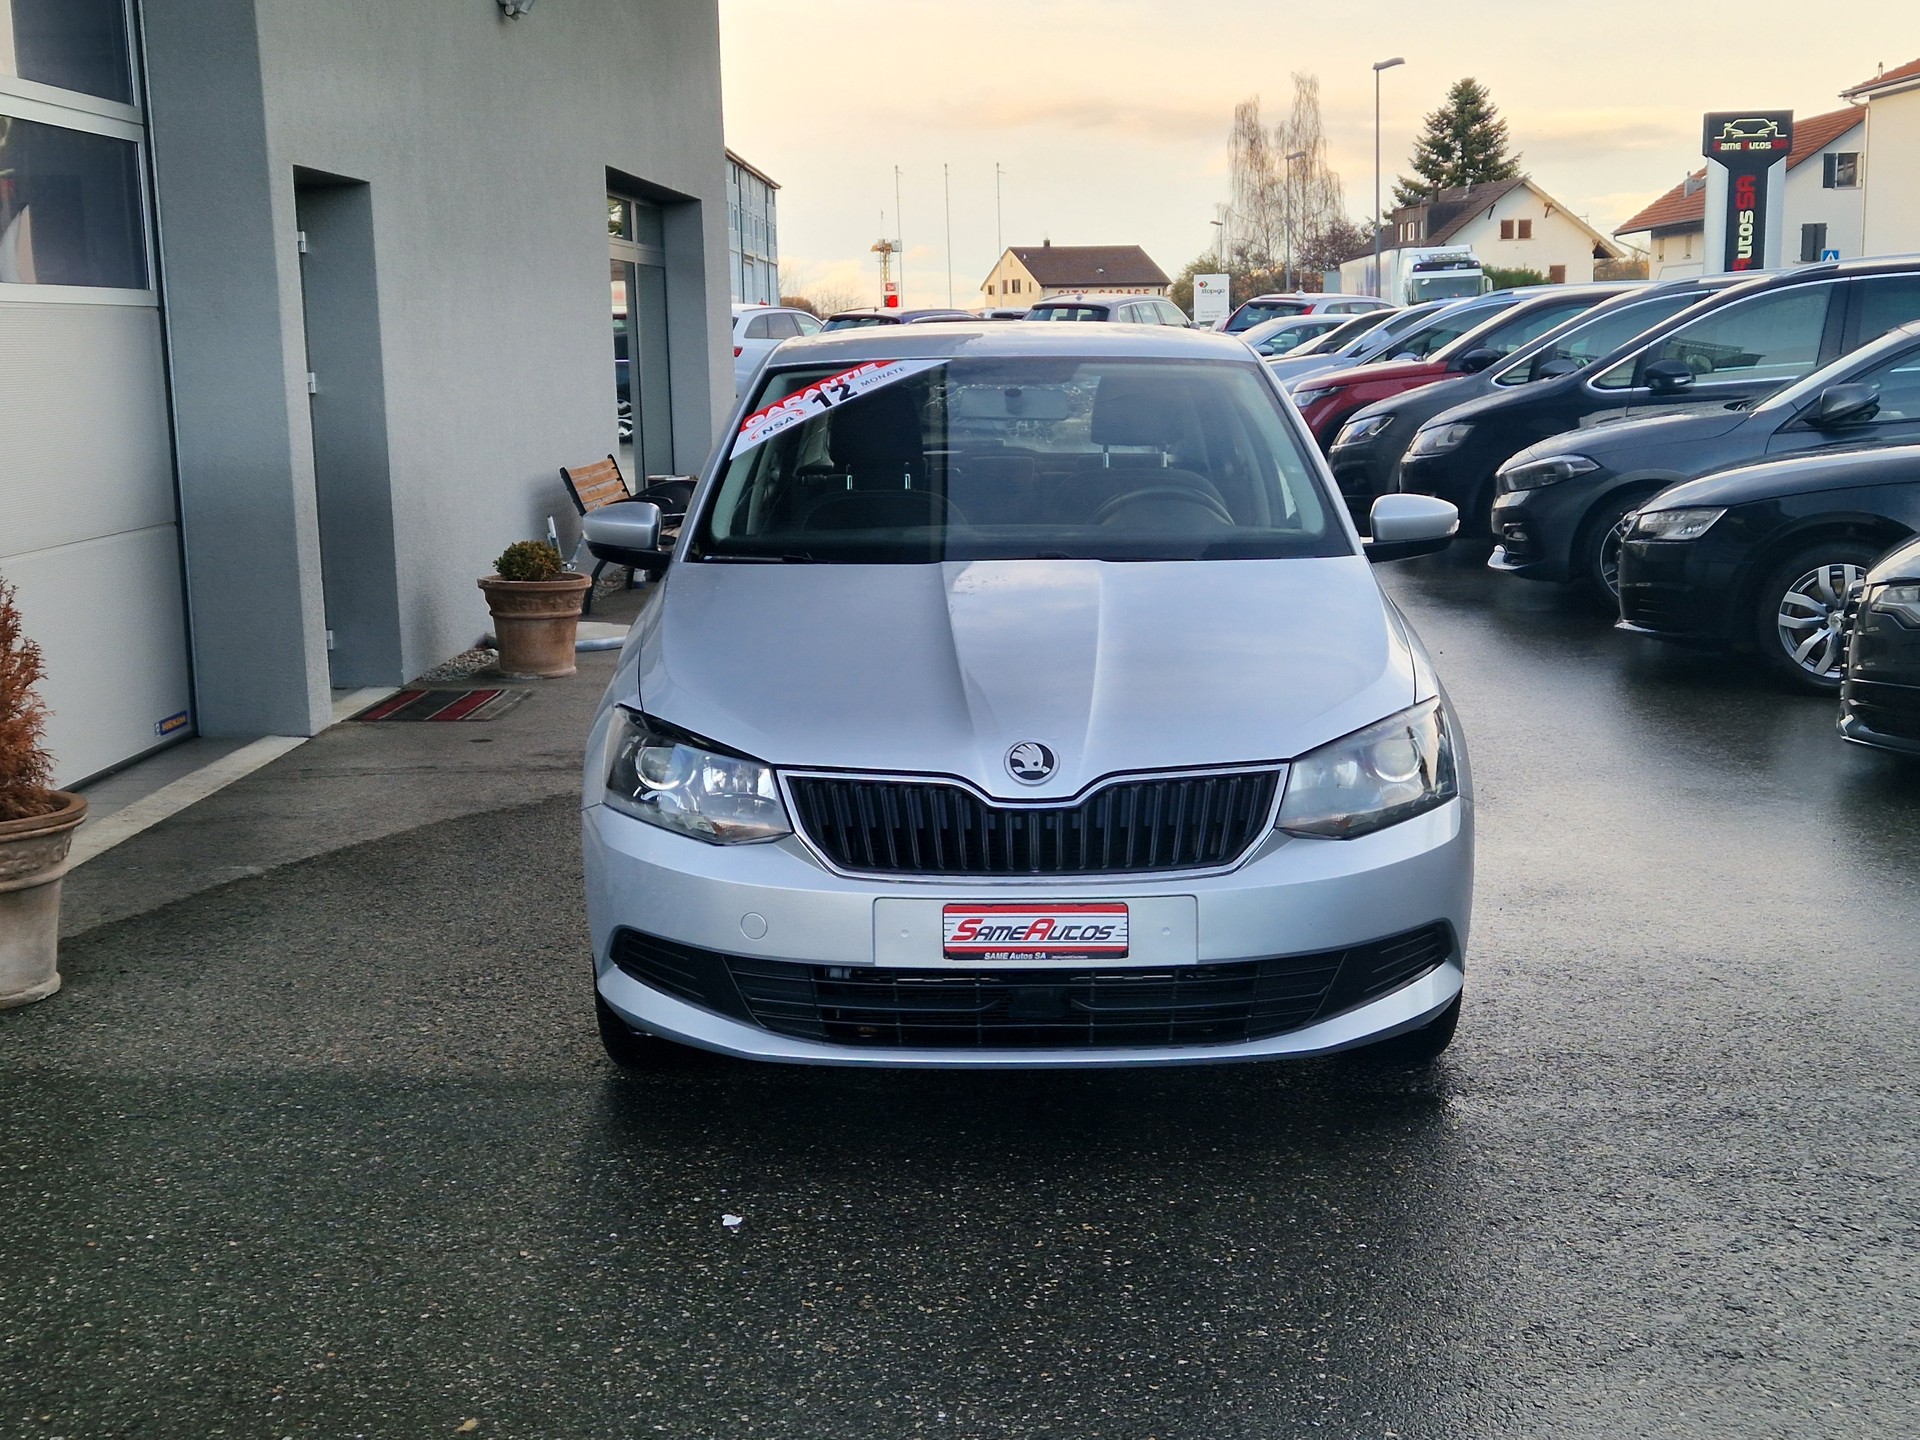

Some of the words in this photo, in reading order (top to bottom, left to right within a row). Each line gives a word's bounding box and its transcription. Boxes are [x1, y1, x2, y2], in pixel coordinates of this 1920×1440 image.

[745, 362, 880, 428] GARANTIE
[811, 383, 858, 409] 12
[860, 366, 907, 388] MONATE
[762, 416, 795, 435] NSA
[984, 952, 1008, 960] SAME
[1009, 952, 1033, 960] Autos
[1034, 952, 1046, 960] SA
